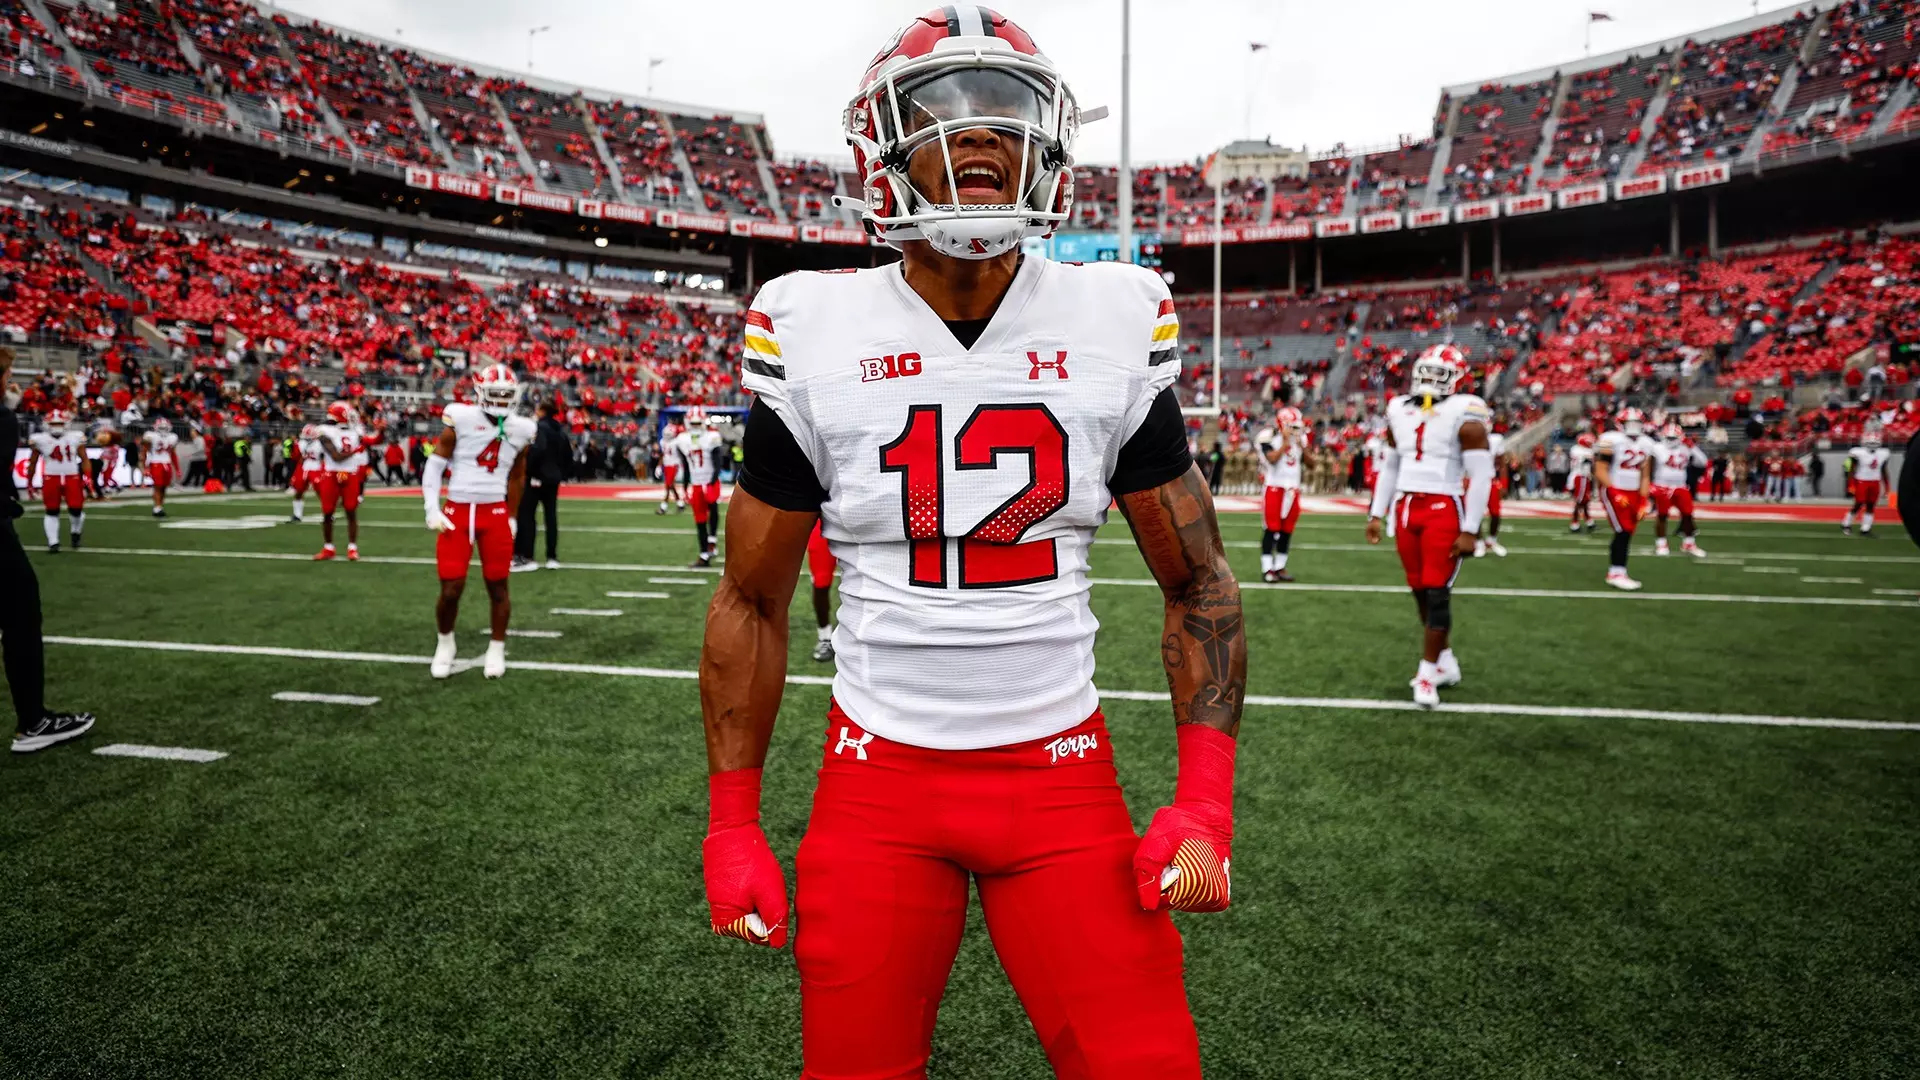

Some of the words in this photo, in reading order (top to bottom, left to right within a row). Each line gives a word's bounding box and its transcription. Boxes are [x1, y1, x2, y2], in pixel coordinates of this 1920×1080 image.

[49, 444, 71, 462] 41
[476, 436, 503, 474] 4
[1414, 421, 1426, 461] 1
[879, 403, 1069, 589] 12
[1207, 685, 1236, 712] 24
[1043, 733, 1098, 764] Terps
